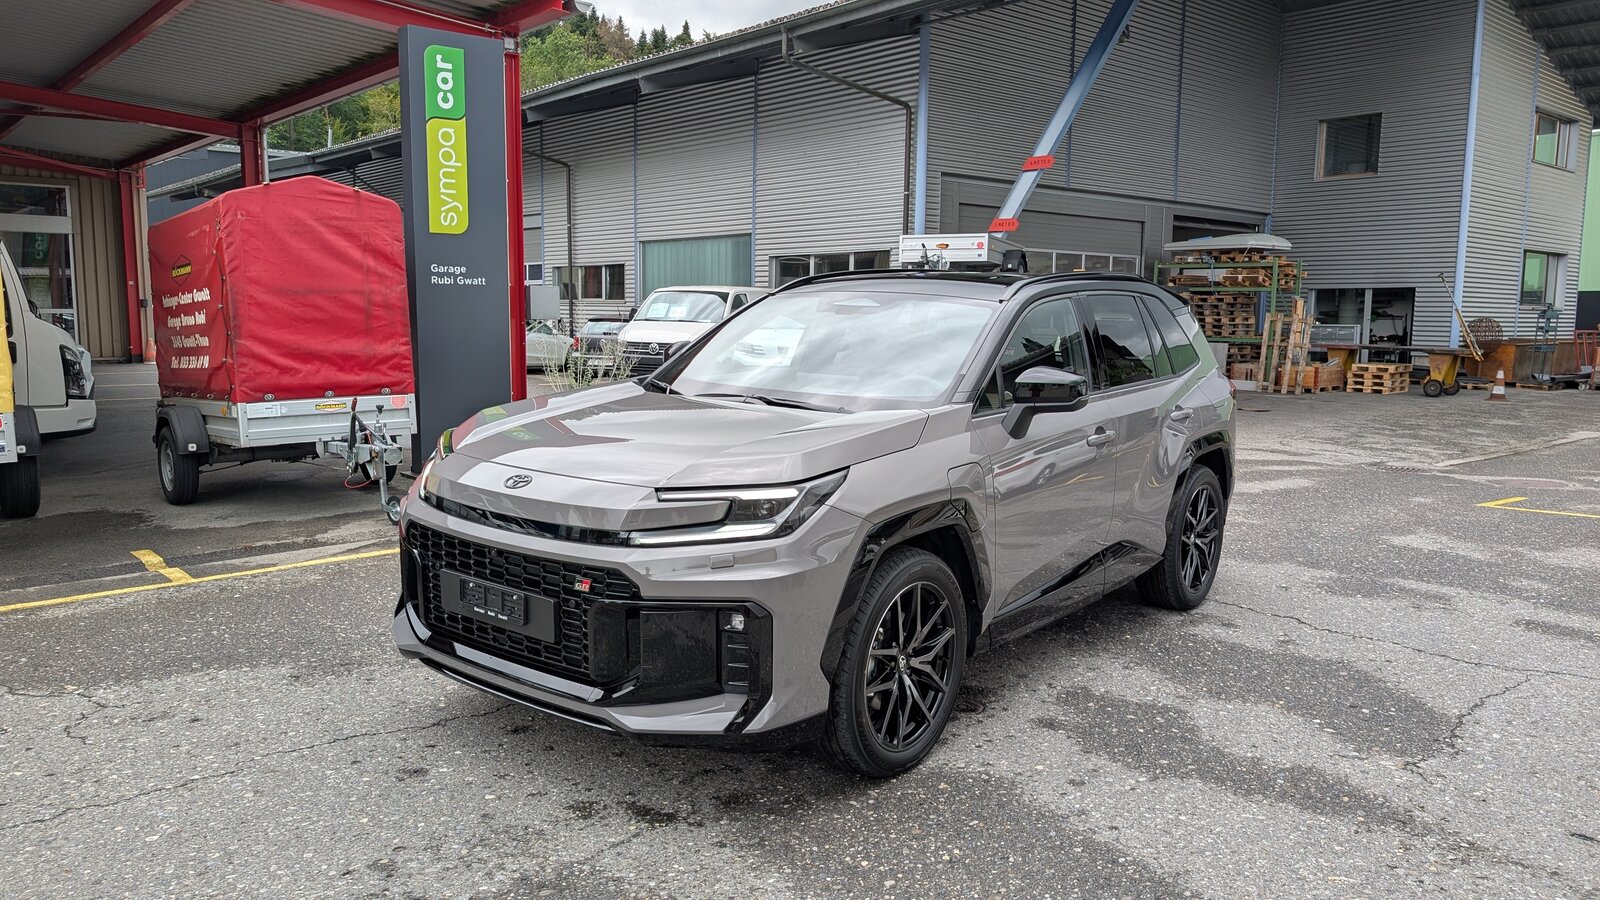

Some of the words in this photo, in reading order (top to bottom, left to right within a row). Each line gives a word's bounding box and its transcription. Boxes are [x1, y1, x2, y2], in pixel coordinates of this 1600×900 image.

[435, 54, 454, 110] car
[437, 127, 463, 226] sympa
[430, 263, 467, 275] Garage
[431, 275, 454, 285] Rubi
[456, 276, 486, 286] Gwatt
[167, 315, 181, 331] Garage
[195, 308, 206, 325] Rubi
[575, 582, 591, 592] GR
